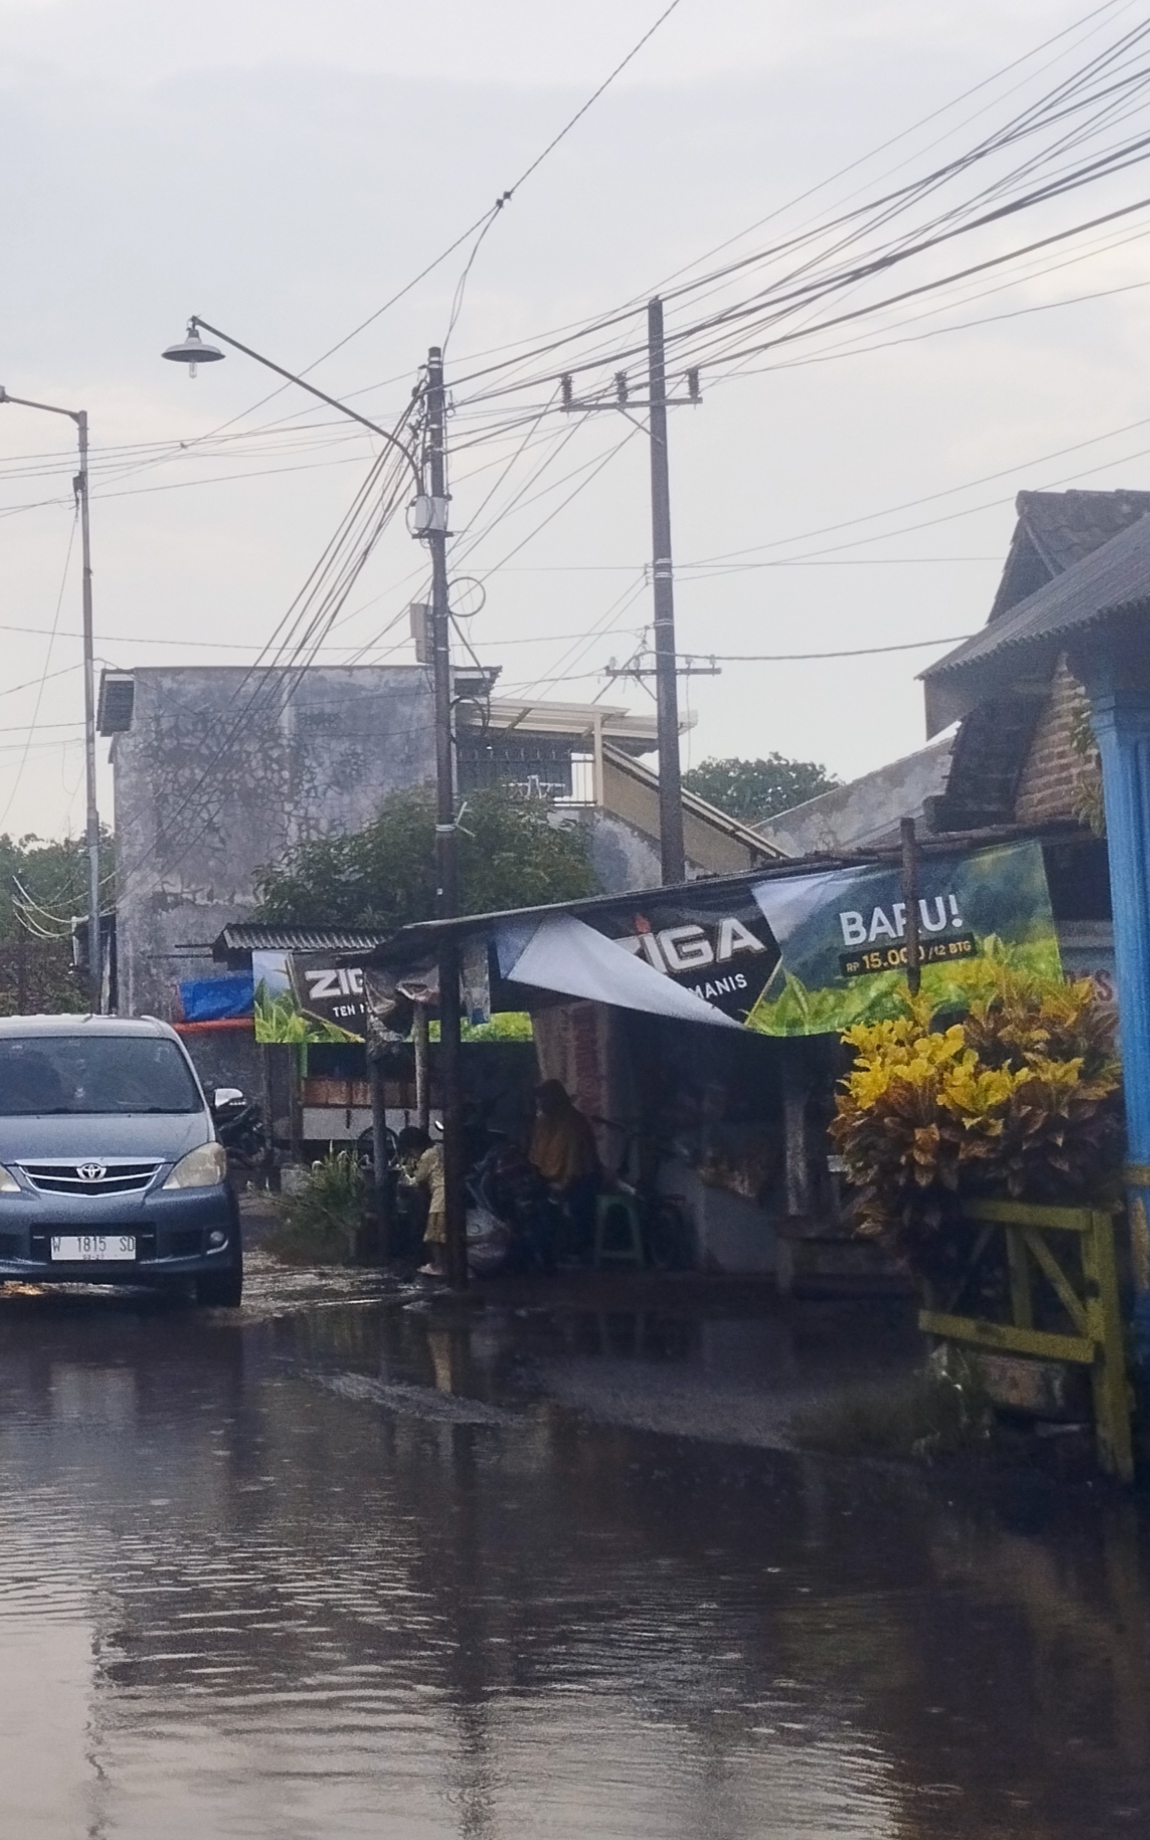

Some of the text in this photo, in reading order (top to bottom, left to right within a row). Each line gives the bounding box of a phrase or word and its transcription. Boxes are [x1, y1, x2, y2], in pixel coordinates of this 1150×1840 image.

[846, 962, 860, 972] RP
[948, 940, 971, 954] BTG
[53, 1236, 135, 1252] W 1815 SD
